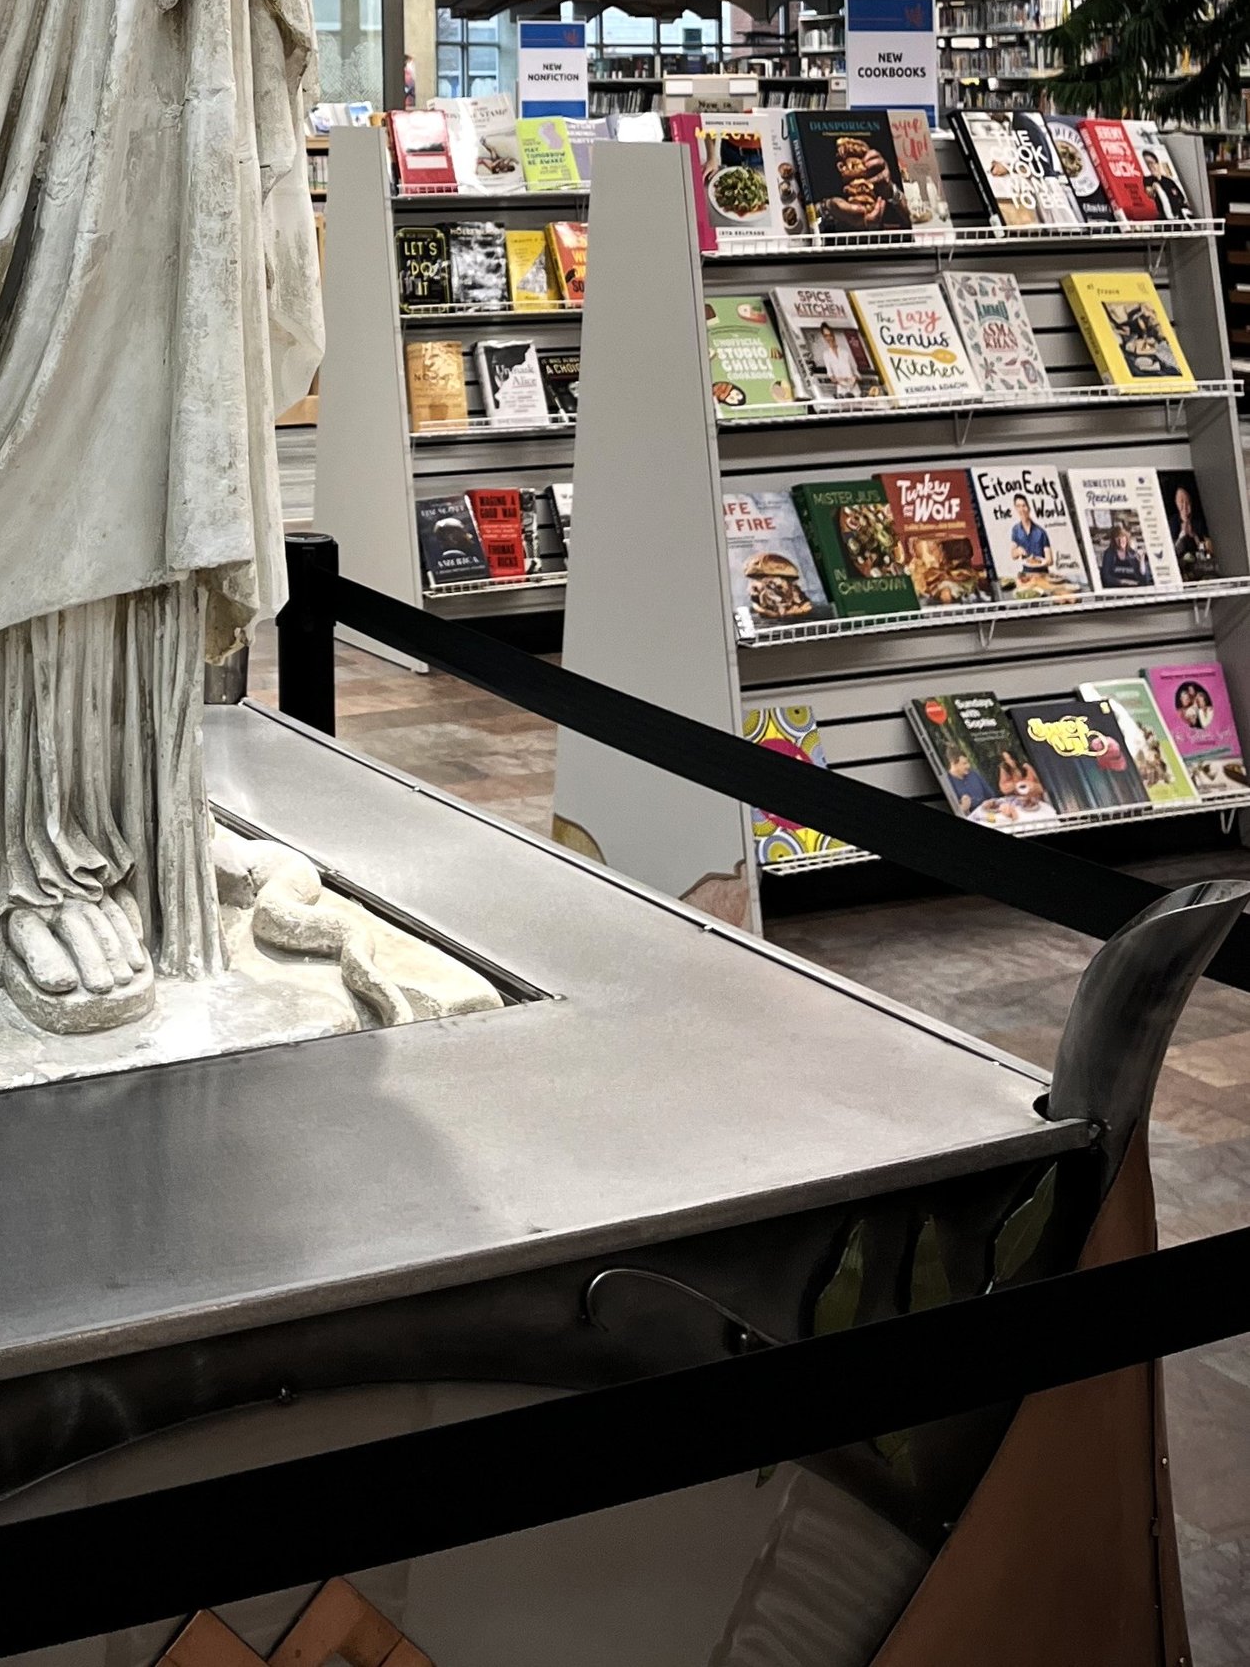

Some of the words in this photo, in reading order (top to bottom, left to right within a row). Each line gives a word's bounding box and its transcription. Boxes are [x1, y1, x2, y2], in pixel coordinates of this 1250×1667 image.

[878, 52, 903, 63] NEW
[543, 63, 562, 71] NEW
[857, 67, 926, 78] COOKBOOKS
[527, 73, 579, 81] NONFICTION
[809, 120, 881, 131] DIASPORICAN
[997, 129, 1032, 148] THE
[990, 145, 1049, 163] COOK
[1001, 160, 1045, 178] YOU
[1007, 175, 1059, 195] WANT
[1010, 192, 1037, 210] TO
[404, 239, 438, 256] LET'S
[797, 291, 833, 303] SPICE
[794, 303, 846, 317] KITCHEN
[873, 312, 896, 324] The
[896, 309, 941, 332] Lazy
[983, 322, 1013, 335] ASMA
[879, 325, 951, 349] Genius
[984, 334, 1019, 349] KHAN
[717, 348, 768, 360] STUDIO
[554, 363, 580, 374] CHOIC
[721, 359, 774, 372] GHIBLI
[890, 355, 965, 382] Kitchen
[512, 376, 538, 386] Alice
[905, 385, 937, 394] KENDRA
[977, 473, 1023, 501] Eitan
[1022, 470, 1058, 499] Eats
[1082, 479, 1126, 488] HOMESTEAD
[813, 492, 853, 505] MISTER
[1086, 491, 1128, 506] Recipes
[723, 502, 751, 516] IFE
[914, 497, 961, 523] WOLF
[993, 505, 1012, 521] the
[1032, 499, 1066, 519] World
[735, 517, 776, 532] FIRE
[834, 569, 848, 581] IN
[838, 578, 907, 595] CHINATOWN
[954, 698, 994, 709] Sundays
